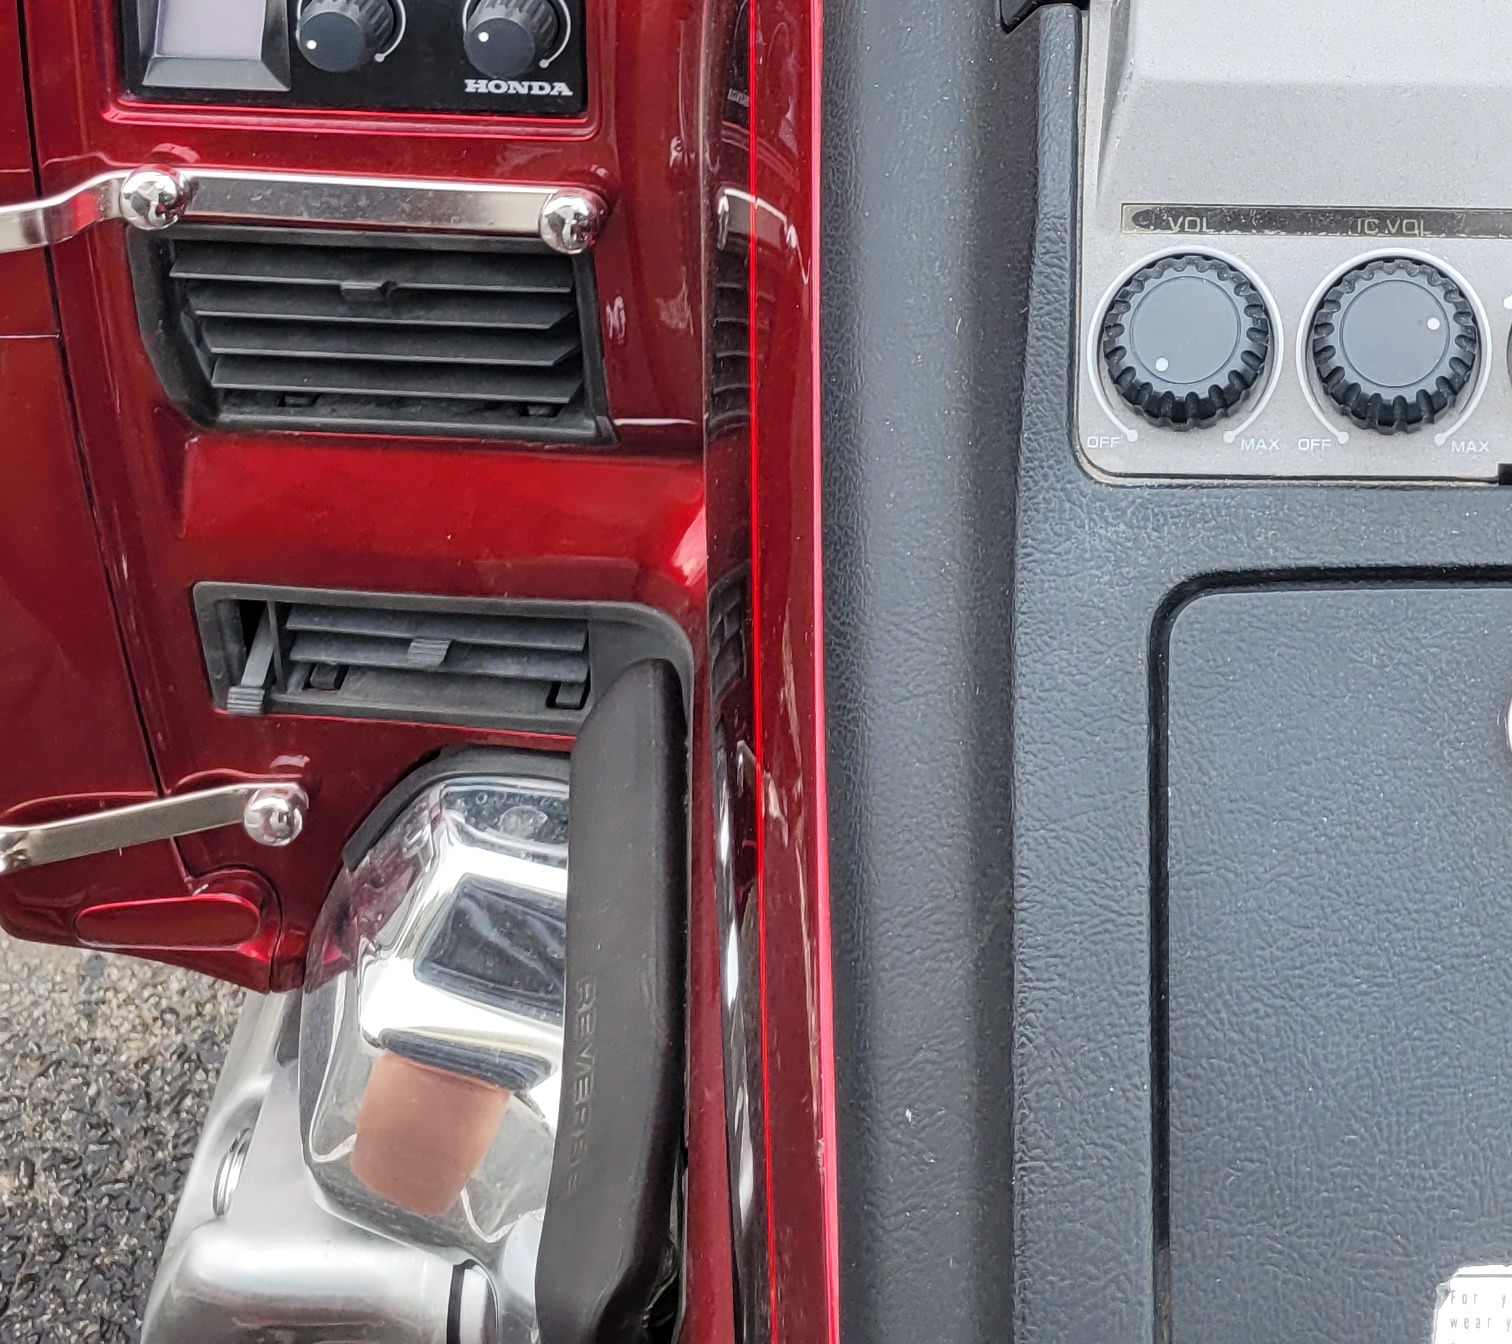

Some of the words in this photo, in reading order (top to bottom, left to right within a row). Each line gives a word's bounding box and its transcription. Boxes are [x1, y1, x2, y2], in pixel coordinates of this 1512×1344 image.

[464, 78, 574, 97] HONDA
[1168, 216, 1210, 232] VOL
[1387, 219, 1432, 235] VOL
[1086, 435, 1121, 449] OFF
[1240, 437, 1280, 451] MAX
[1297, 438, 1332, 452] OFF
[1451, 439, 1491, 453] MAX
[1450, 1289, 1478, 1305] For
[1450, 1317, 1492, 1330] wear
